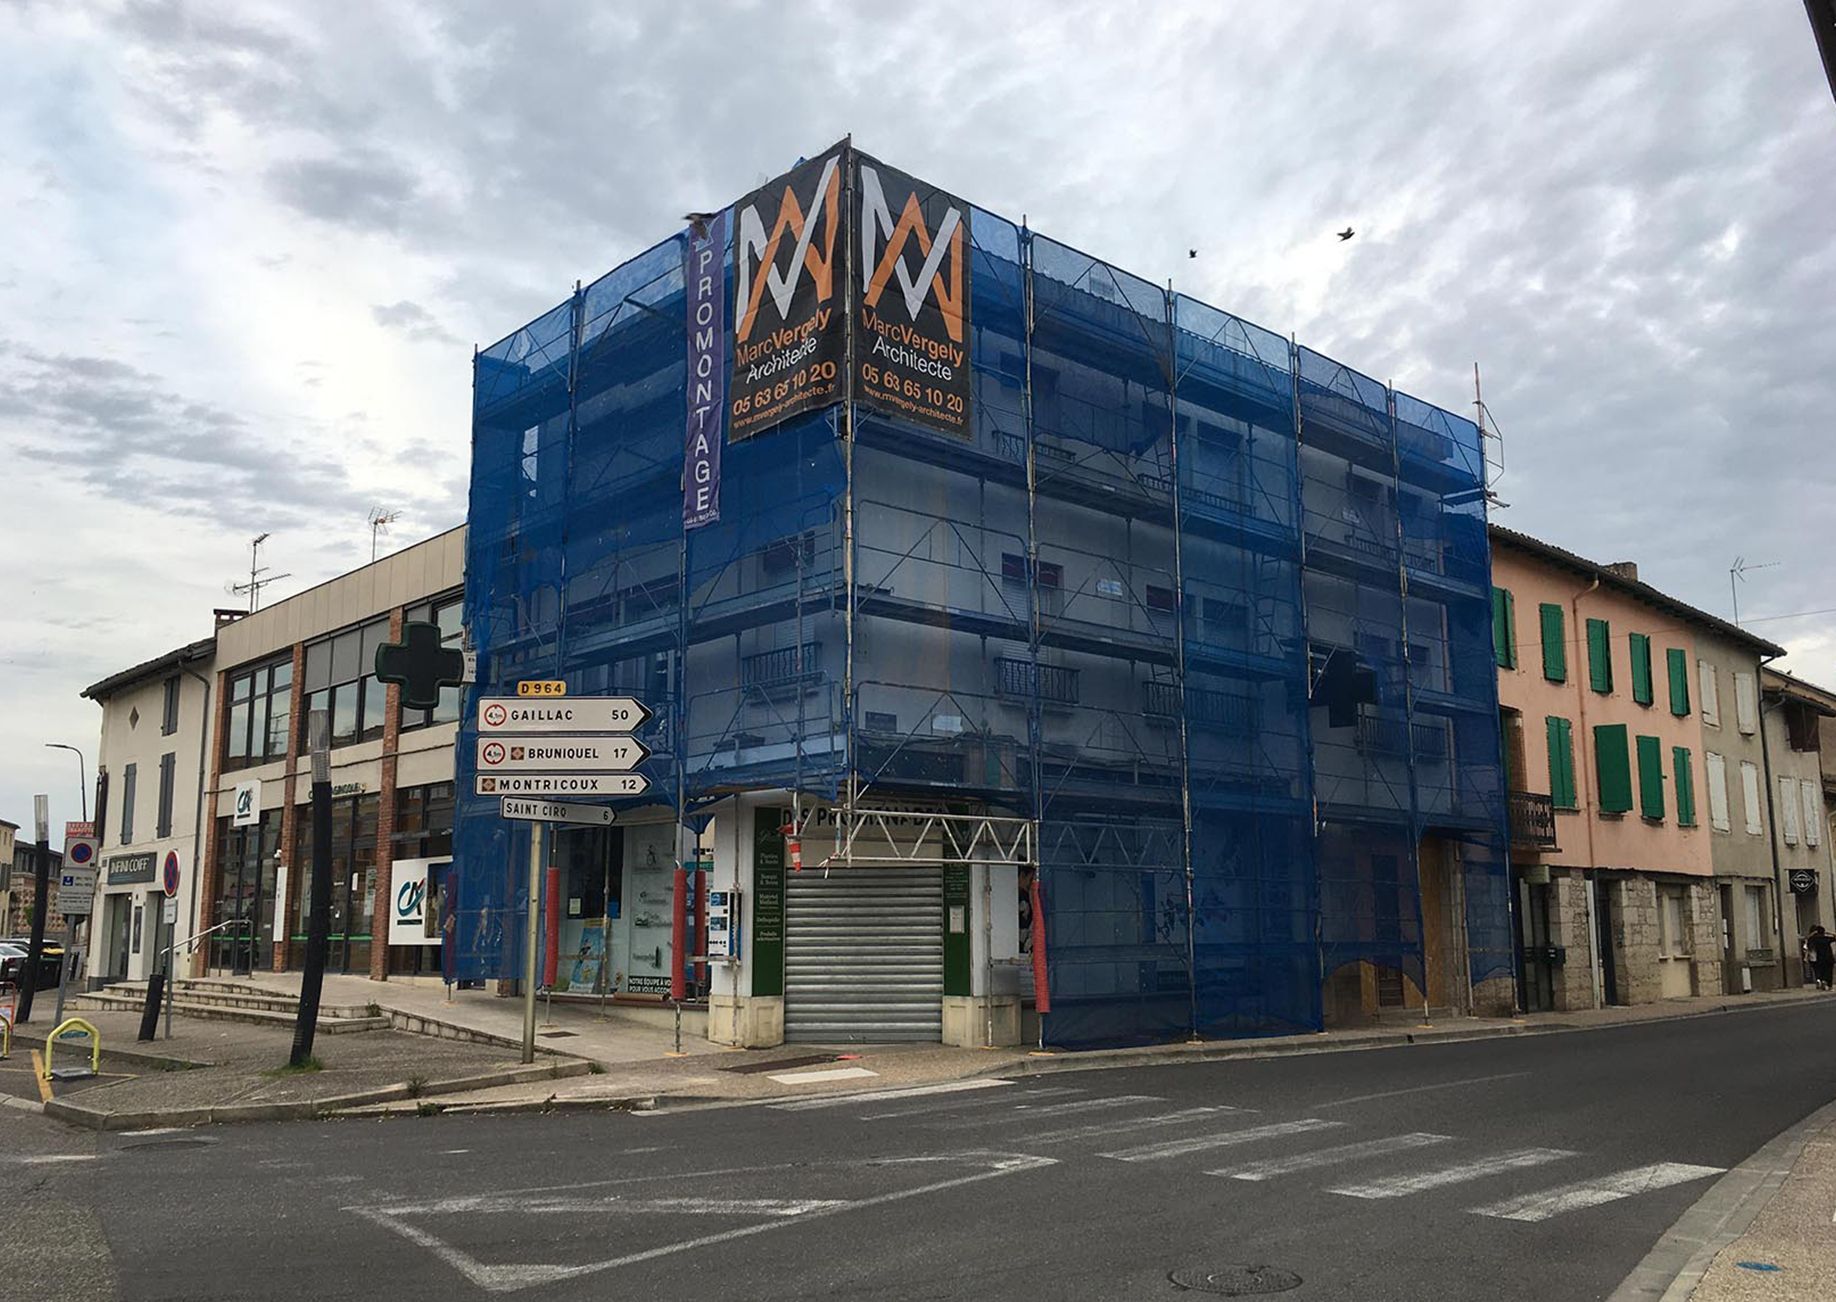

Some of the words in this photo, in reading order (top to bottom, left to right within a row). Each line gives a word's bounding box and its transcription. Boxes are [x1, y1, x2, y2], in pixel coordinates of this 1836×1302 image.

[872, 336, 952, 381] Architecte
[695, 250, 713, 511] PROMONTAGE
[733, 396, 751, 416] 05
[754, 388, 772, 408] 63
[792, 369, 807, 389] 10
[810, 361, 837, 382] 20
[862, 363, 879, 384] 05
[883, 371, 900, 391] 63
[903, 380, 921, 399] 65
[925, 387, 943, 406] 10
[947, 393, 963, 413] 20
[521, 683, 530, 694] D
[533, 683, 562, 694] 964
[511, 710, 573, 721] GAILLAC
[611, 709, 629, 721] 50
[528, 748, 599, 760] BRUNIQUEL
[613, 748, 628, 759] 17
[500, 779, 599, 790] MONTRICOUX
[621, 779, 637, 790] 12
[506, 802, 538, 815] SAINT
[603, 810, 609, 821] 6
